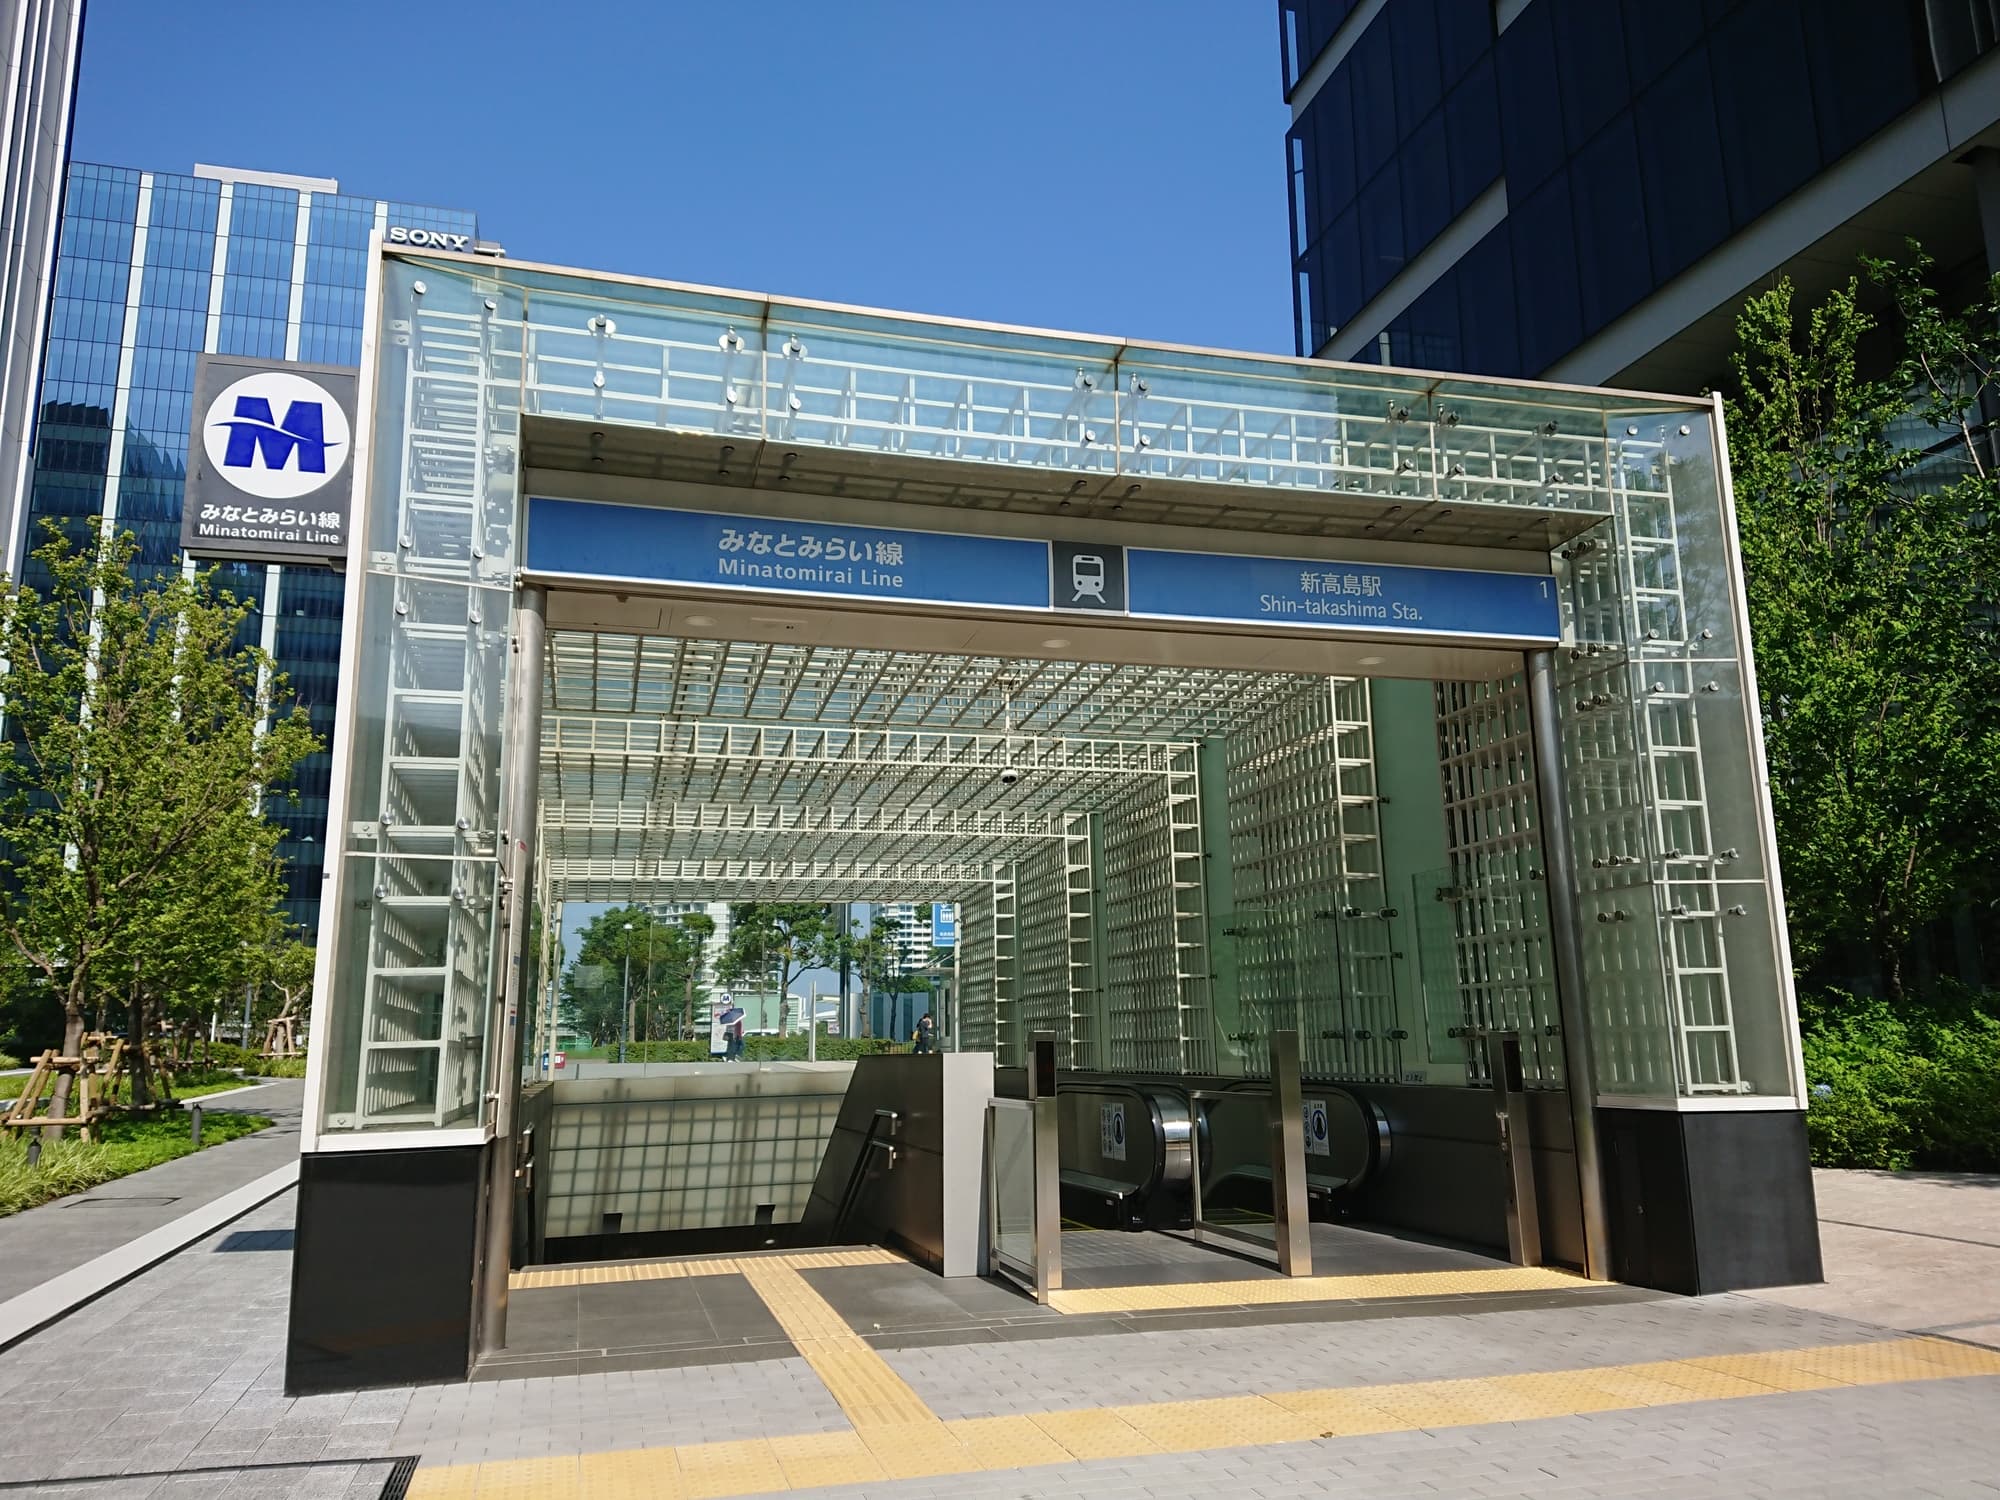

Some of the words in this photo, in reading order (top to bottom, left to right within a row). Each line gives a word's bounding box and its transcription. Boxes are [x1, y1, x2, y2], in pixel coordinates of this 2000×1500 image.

[390, 226, 469, 248] SONY
[211, 395, 343, 474] M
[200, 503, 341, 529] みなとみらい線
[199, 523, 300, 541] Minatomirai
[305, 530, 340, 544] Line
[718, 528, 904, 566] みなとみらい線
[718, 558, 852, 584] Minatomirai
[861, 569, 904, 588] Line
[1300, 571, 1383, 597] 新高島駅
[1540, 580, 1548, 598] 1
[1260, 594, 1387, 618] Shin-takashima
[1392, 602, 1423, 620] Sta.
